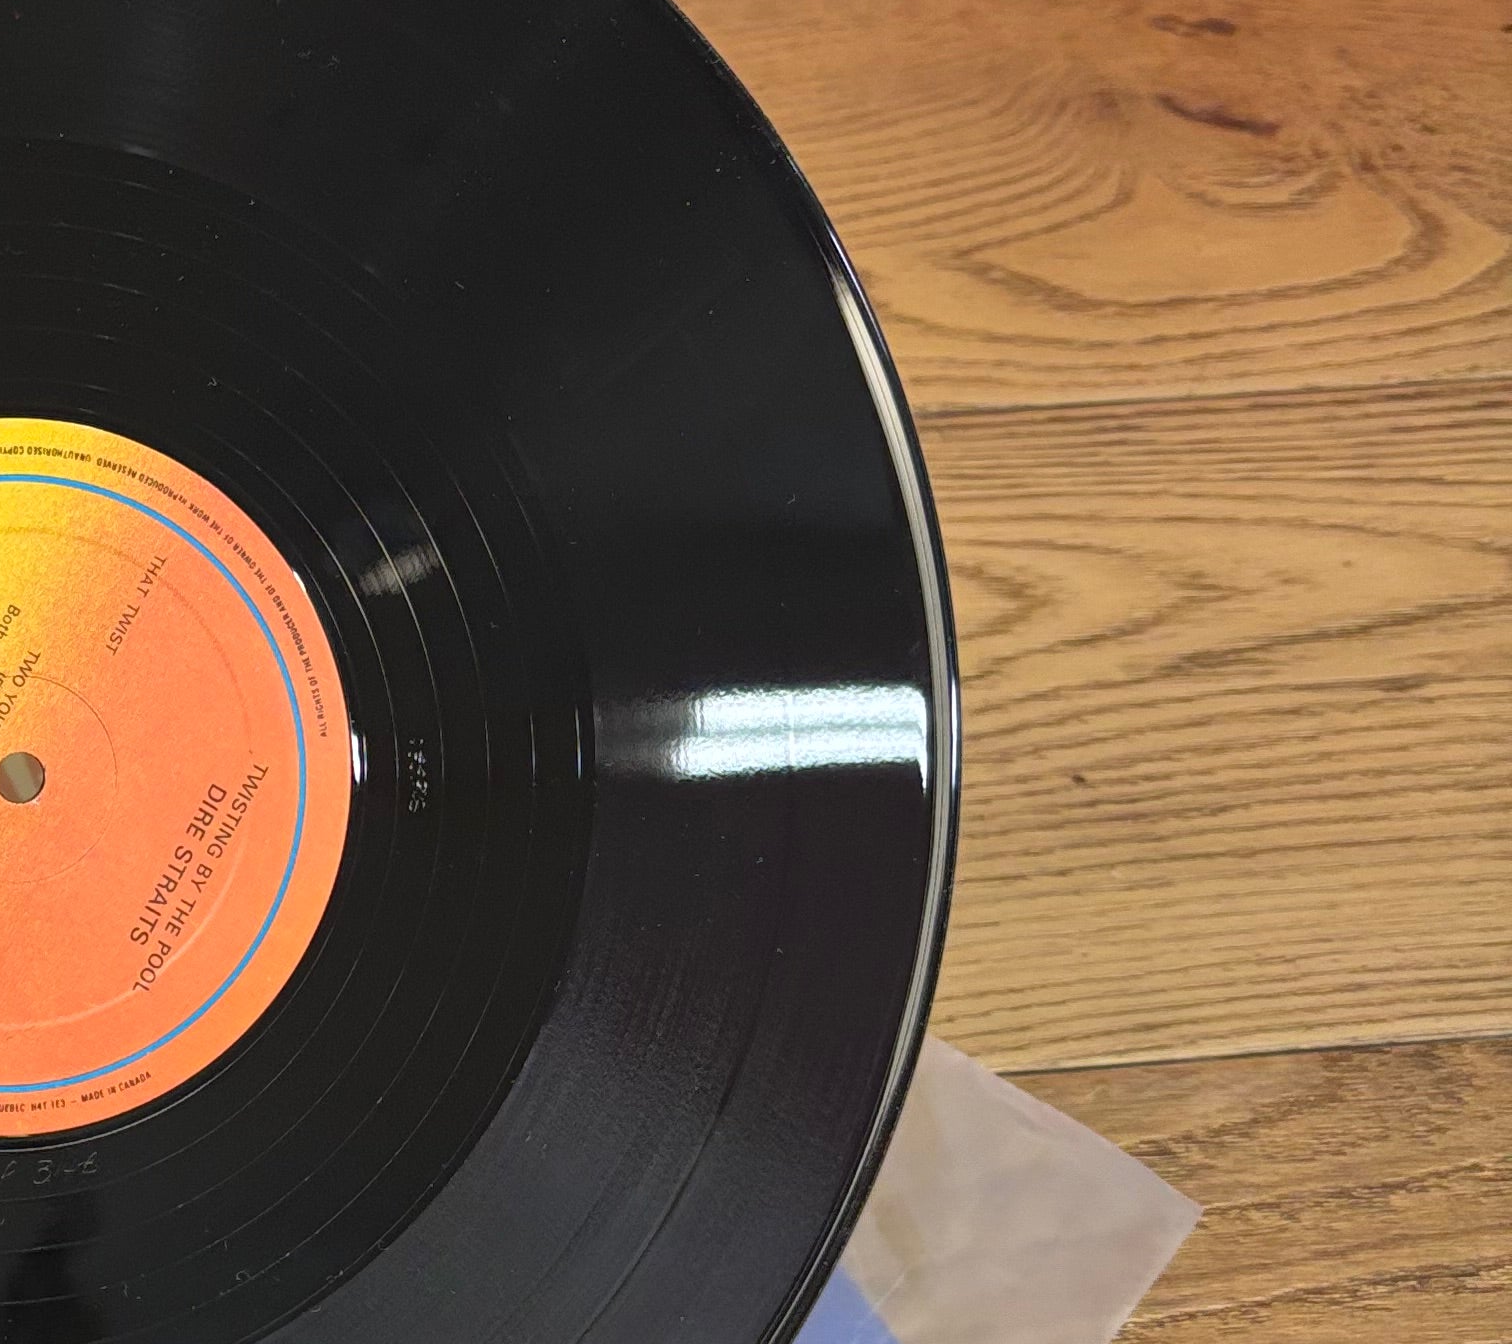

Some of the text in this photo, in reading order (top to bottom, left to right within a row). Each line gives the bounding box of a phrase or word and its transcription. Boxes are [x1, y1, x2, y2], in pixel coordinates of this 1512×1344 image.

[26, 445, 92, 463] UNAUTHORISED
[186, 502, 211, 523] WORK
[208, 519, 224, 535] THE
[222, 532, 234, 545] OF
[231, 542, 257, 570] OWNER
[252, 567, 268, 585] THE
[264, 583, 276, 596] OF
[105, 555, 168, 657] THAT TWIST
[271, 594, 286, 613] AND
[281, 611, 307, 656] PRODUCER
[11, 650, 42, 688] TWO
[300, 655, 313, 672] THE
[307, 674, 317, 686] OF
[310, 687, 324, 719] RIGHTS
[317, 721, 327, 737] ALL
[129, 783, 228, 946] DIRE STRAITS
[131, 764, 270, 992] TWISTING BY THE POOL
[80, 1089, 104, 1103] MADE
[107, 1085, 117, 1095] IN
[117, 1069, 151, 1091] CANADA
